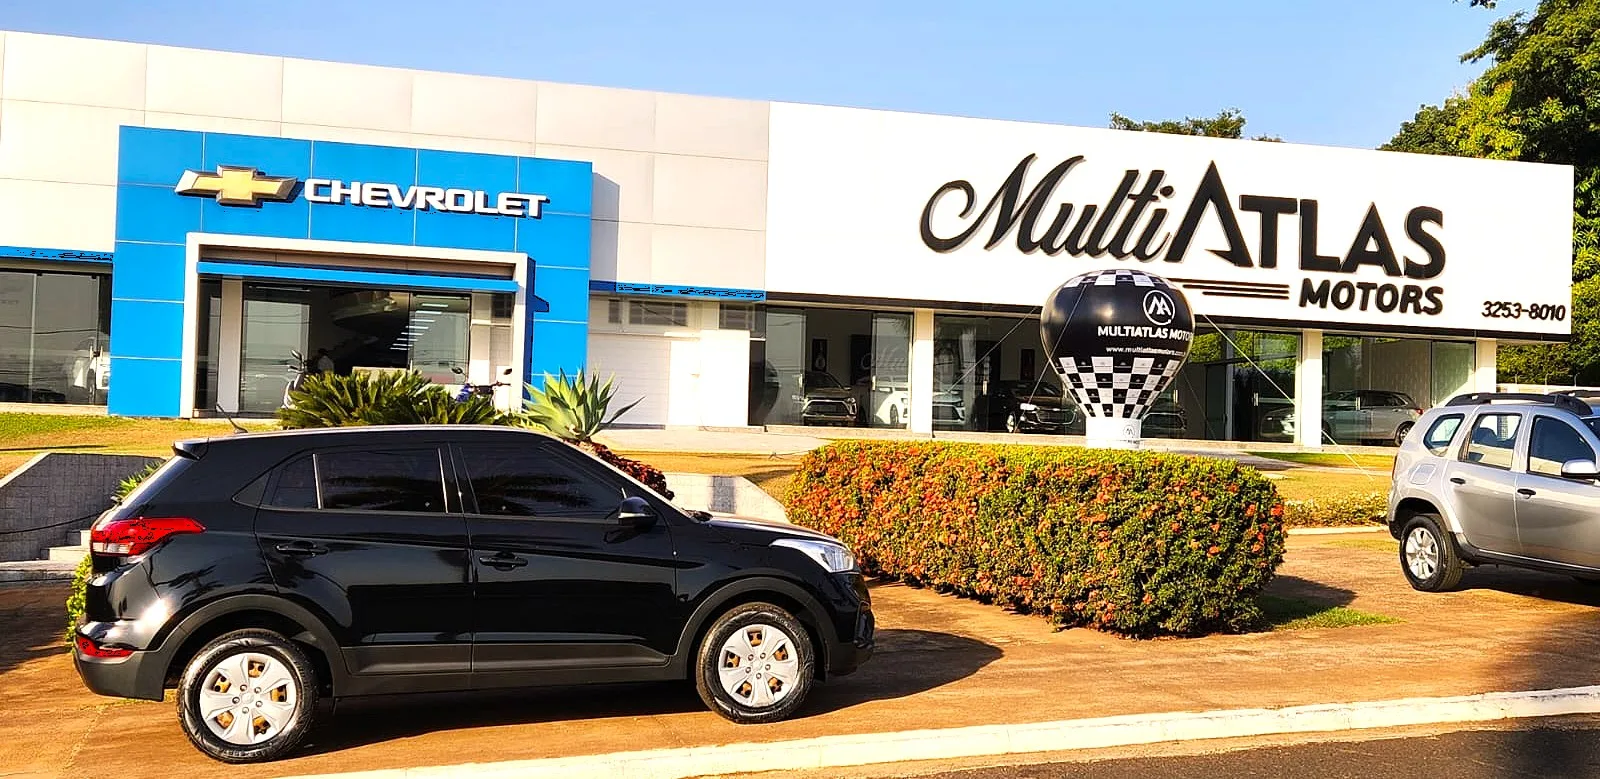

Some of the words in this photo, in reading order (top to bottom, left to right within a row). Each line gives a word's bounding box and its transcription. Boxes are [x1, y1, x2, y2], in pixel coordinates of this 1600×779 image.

[304, 177, 548, 219] CHEVROLET
[1298, 277, 1445, 316] MOTORS
[1480, 299, 1567, 322] 3253-8010
[1097, 325, 1168, 339] MULTIATLAS
